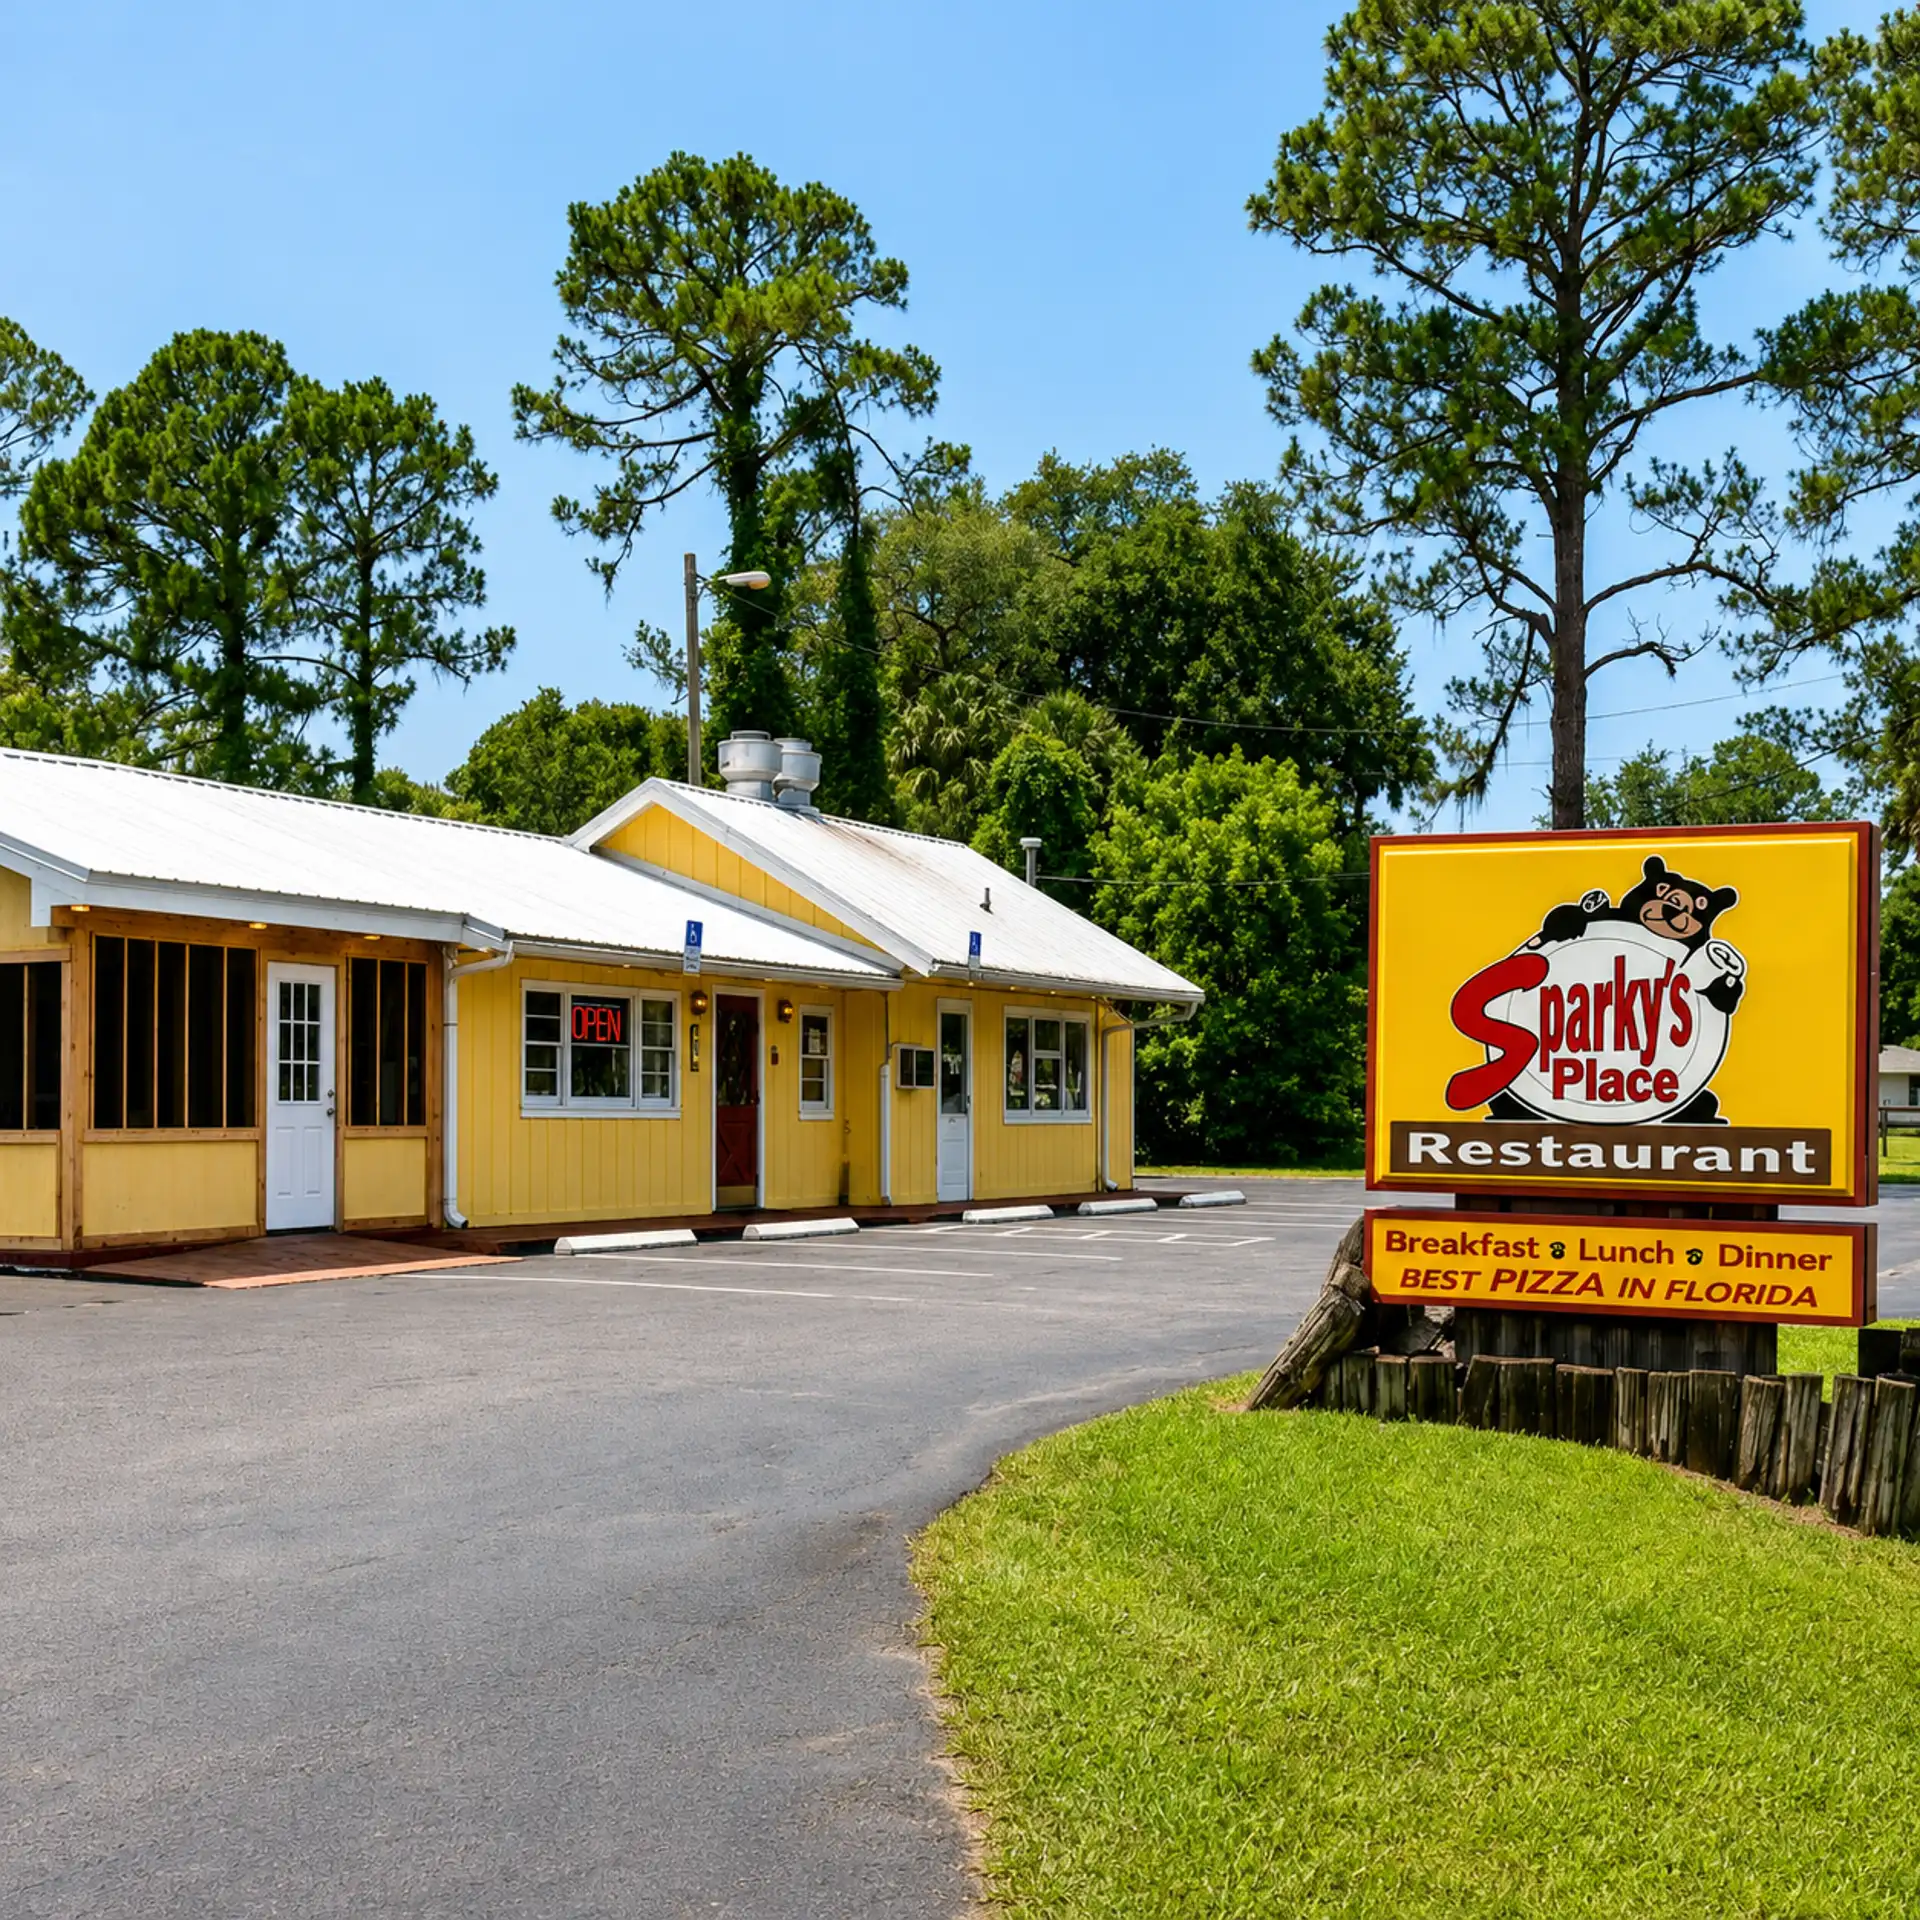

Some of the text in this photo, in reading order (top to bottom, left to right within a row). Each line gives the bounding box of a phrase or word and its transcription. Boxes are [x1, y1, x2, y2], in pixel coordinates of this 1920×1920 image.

[572, 1006, 621, 1042] OPEN
[1445, 953, 1693, 1110] Sparky's
[1552, 1058, 1679, 1102] Place
[1407, 1131, 1816, 1174] Restaurant
[1385, 1230, 1832, 1271] Breakfast Lunch Dinner
[1400, 1268, 1818, 1307] BEST PIZZA IN FLORIDA
